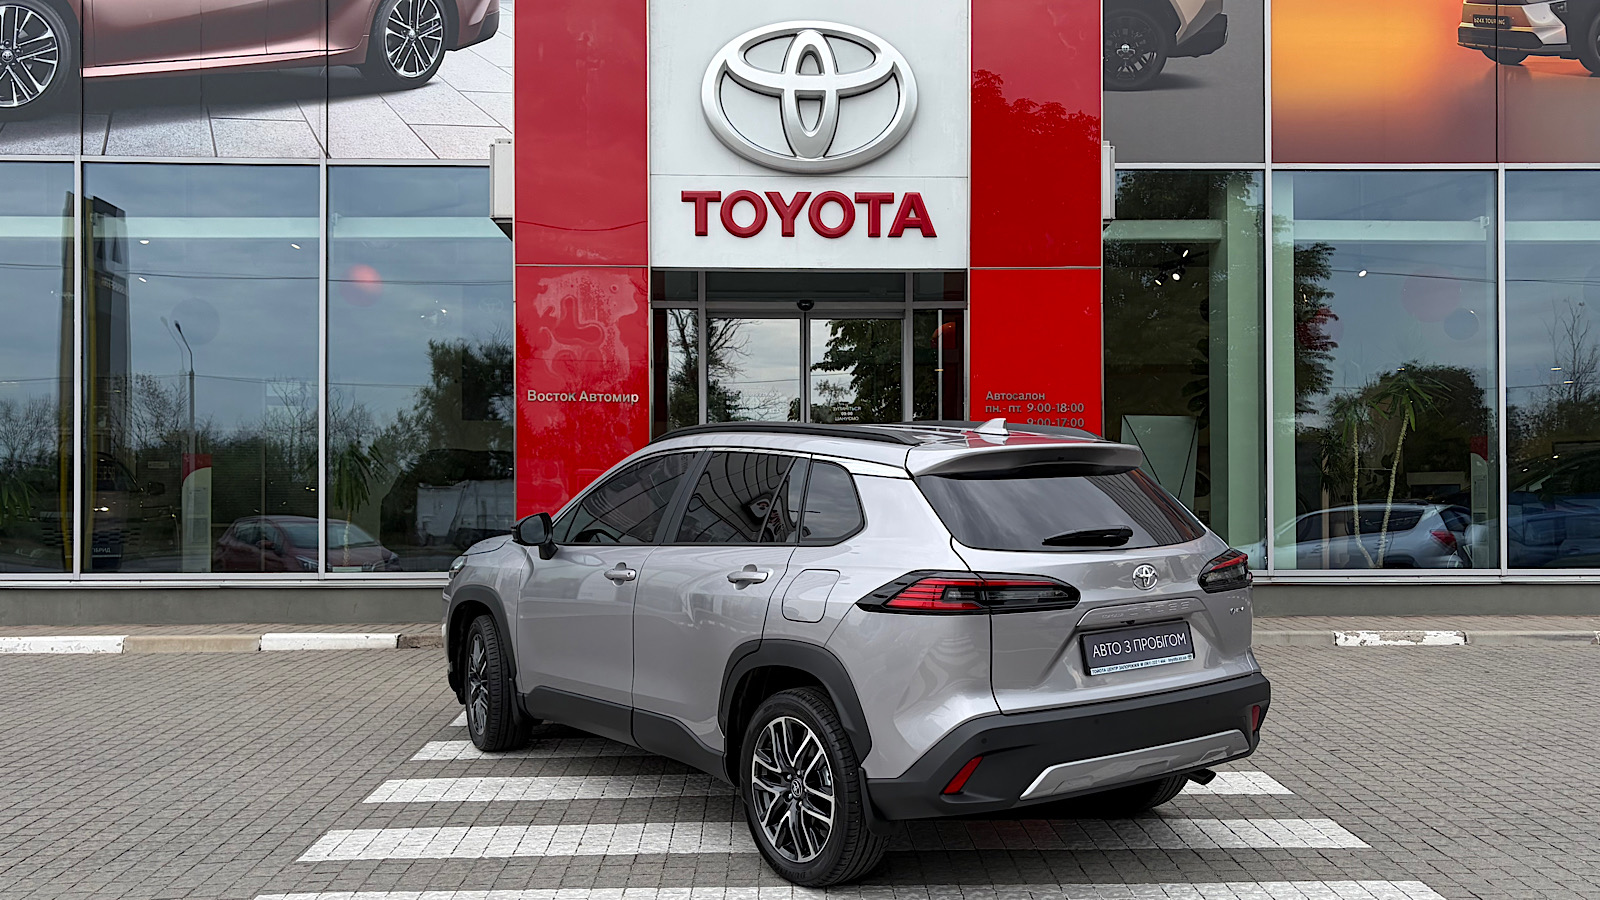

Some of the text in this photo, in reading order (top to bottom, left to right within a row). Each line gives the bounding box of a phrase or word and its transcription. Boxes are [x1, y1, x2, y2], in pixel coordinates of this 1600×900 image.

[681, 189, 937, 239] TOYOTA
[527, 389, 640, 405] Восток Автомир
[985, 390, 1046, 401] Автосалон
[1092, 641, 1122, 658] АВТО
[1133, 632, 1187, 652] ПРОБІГОМ
